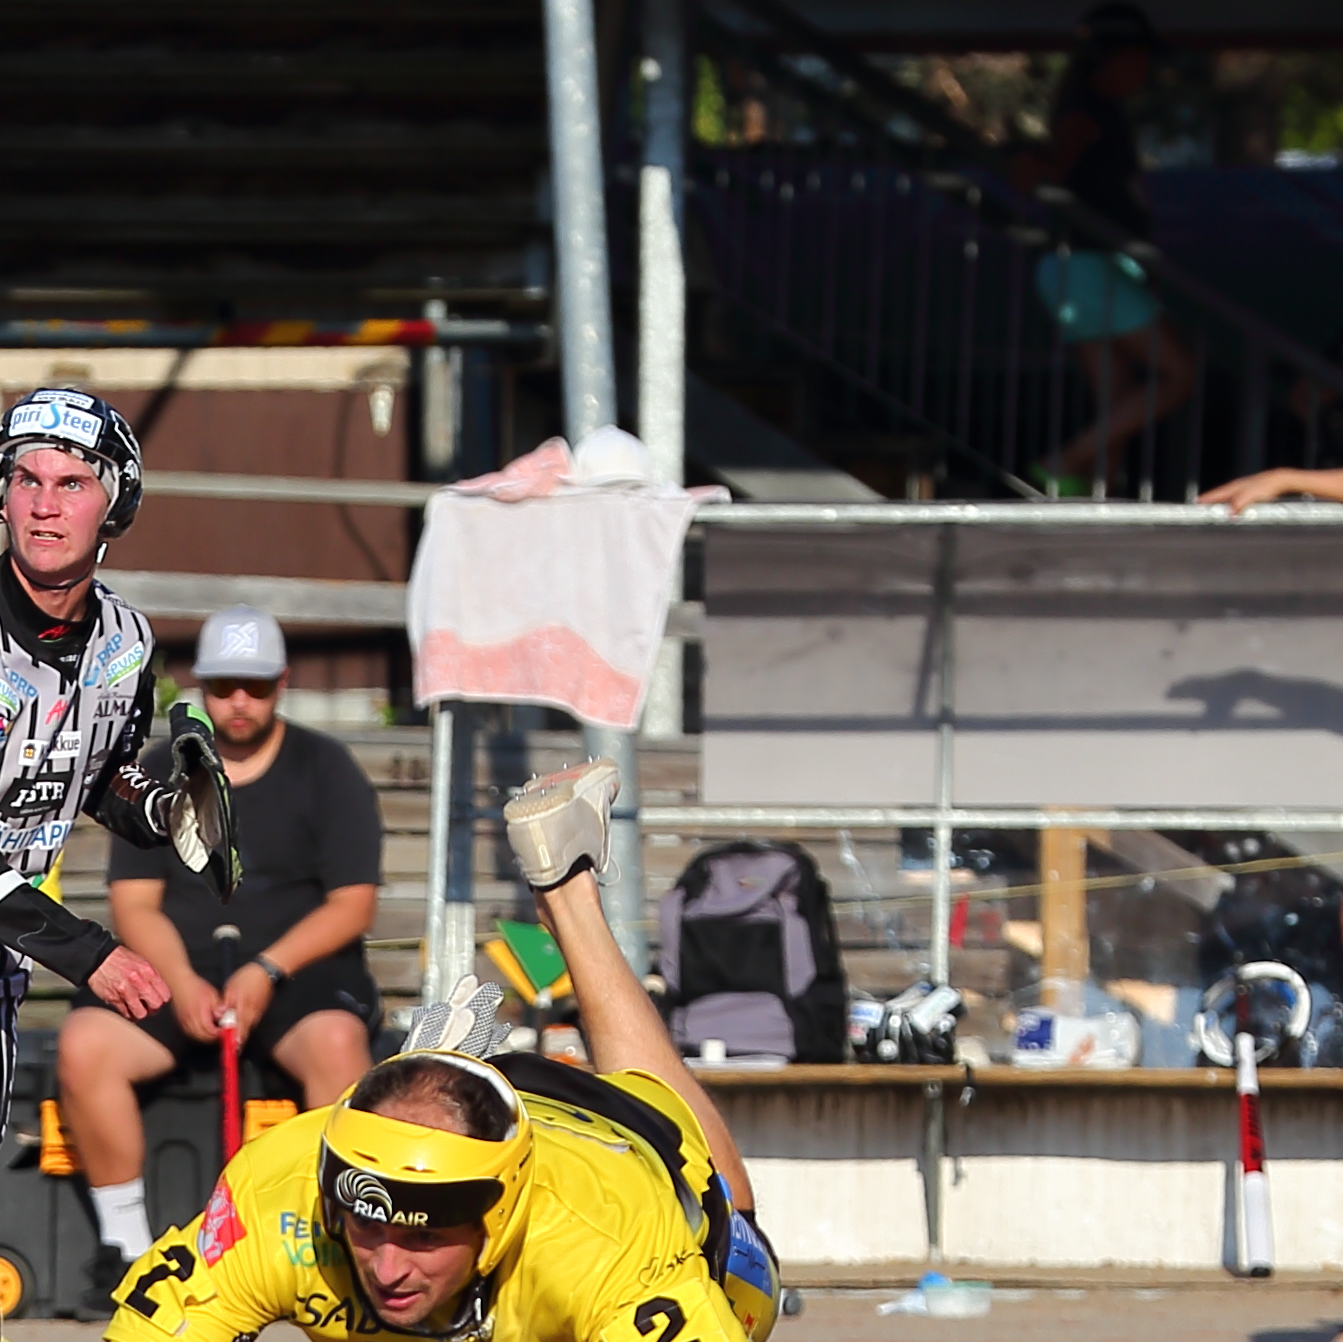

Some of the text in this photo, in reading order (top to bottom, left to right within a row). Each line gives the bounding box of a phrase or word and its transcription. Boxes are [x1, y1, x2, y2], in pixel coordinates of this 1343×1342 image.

[97, 633, 123, 667] PRP
[391, 1211, 429, 1226] AIR
[126, 1243, 197, 1319] 2
